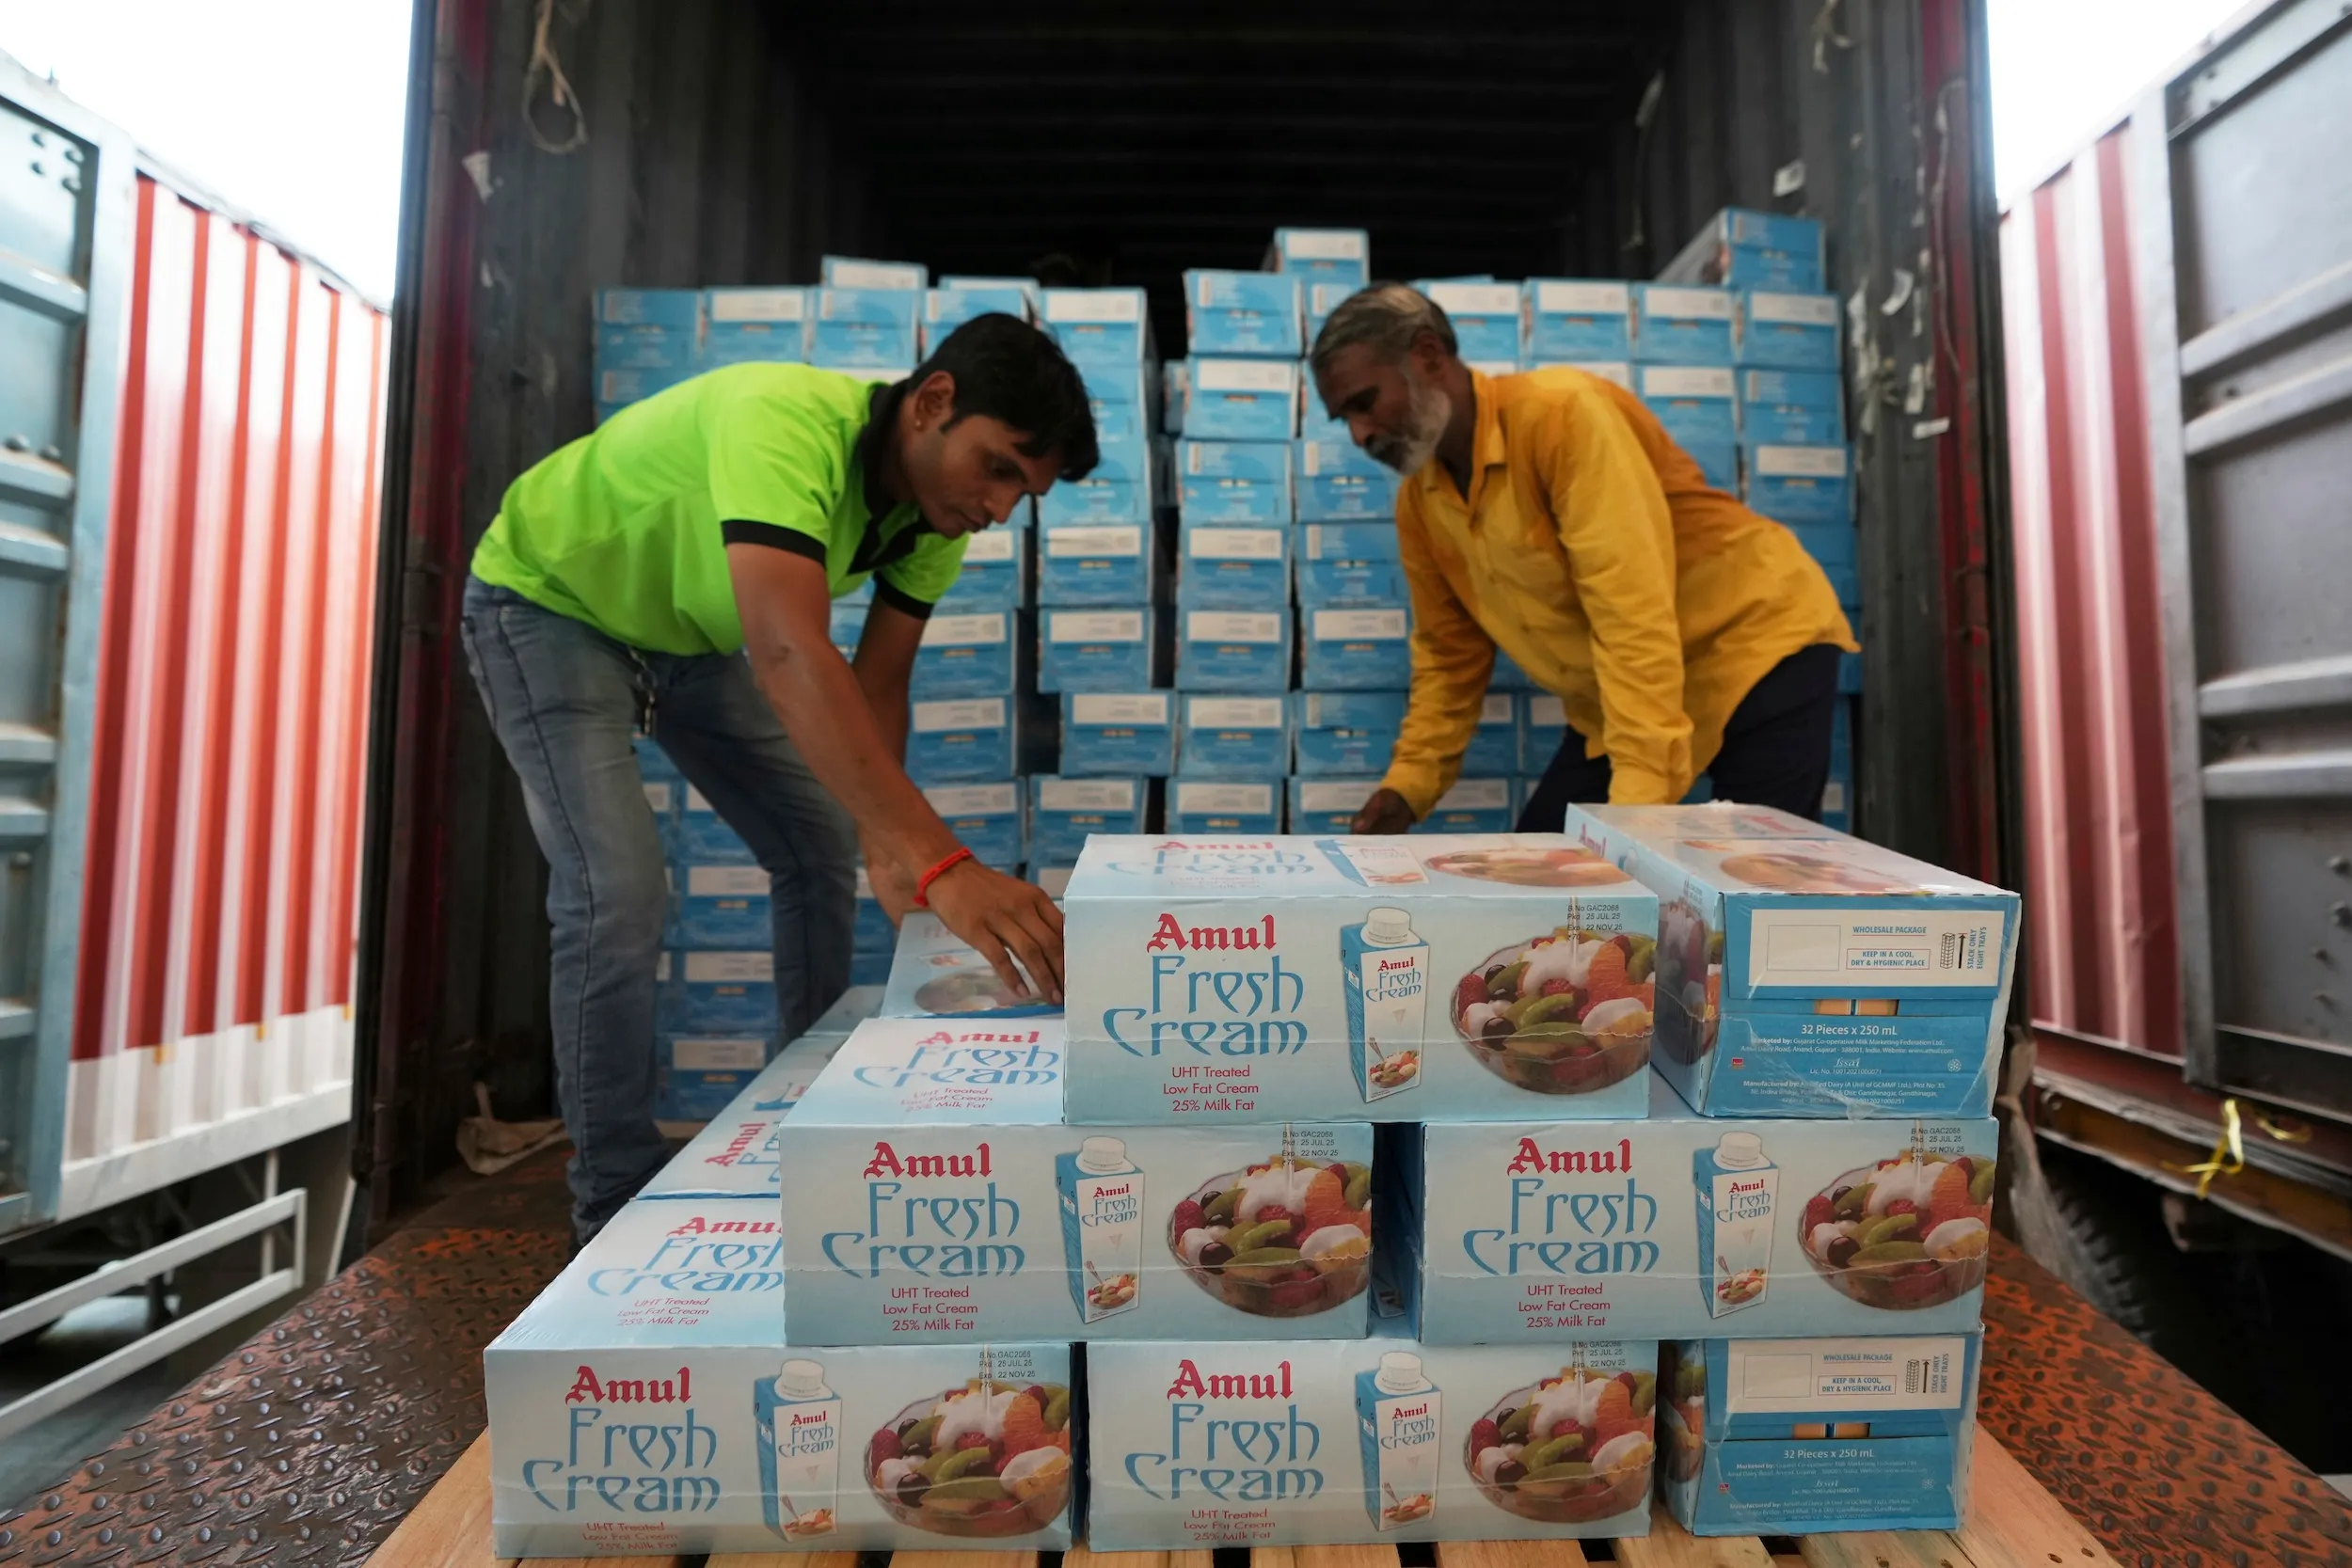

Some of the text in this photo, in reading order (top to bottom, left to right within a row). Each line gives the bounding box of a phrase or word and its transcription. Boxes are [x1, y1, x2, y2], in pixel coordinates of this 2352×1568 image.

[1147, 913, 1277, 953] Amul
[1977, 927, 1987, 969] EIGHT TRAYS
[1377, 957, 1414, 972] Amul
[1152, 955, 1303, 1017] Fresh
[1378, 967, 1422, 990] Fresh
[1365, 984, 1422, 1003] Cream
[915, 1031, 1040, 1046] Amul
[1103, 1008, 1308, 1057] Cream
[1802, 1024, 1898, 1036] 32 Pieces x 250 mL
[906, 1045, 1059, 1069] Fresh
[853, 1066, 1057, 1088] Cream
[1172, 1065, 1250, 1078] UHT Treated
[1163, 1083, 1259, 1095] Low Fat Cream
[1172, 1099, 1255, 1112] 25% Milk Fat
[704, 1122, 767, 1167] Amul
[863, 1141, 993, 1180] Amul
[1507, 1137, 1632, 1176] Amul
[1093, 1183, 1129, 1199] Amul
[1729, 1179, 1764, 1194] Amul
[1094, 1195, 1136, 1215] Fresh
[1511, 1178, 1658, 1238] Fresh
[1729, 1190, 1771, 1211] Fresh
[868, 1181, 1020, 1242] Fresh
[1082, 1211, 1137, 1227] Cream
[1716, 1205, 1771, 1223] Cream
[666, 1216, 781, 1237] Amu
[821, 1232, 1025, 1279] Cream
[1463, 1229, 1660, 1275] Cream
[588, 1269, 784, 1296] Cream
[1528, 1282, 1603, 1296] UHT Treated
[891, 1286, 969, 1299] UHT Treated
[634, 1299, 661, 1307] UHT
[882, 1303, 978, 1315] Low Fat Cream
[1518, 1299, 1611, 1312] Low Fat Cream
[647, 1317, 675, 1325] Milk
[892, 1318, 975, 1331] 25% Milk Fat
[1527, 1315, 1606, 1328] 25% Milk Fat
[564, 1366, 691, 1405] Amul
[1167, 1359, 1294, 1401] Amul
[790, 1410, 827, 1427] Amul
[1392, 1403, 1427, 1419] Amul
[791, 1422, 834, 1445] Fresh
[1172, 1403, 1320, 1465] Fresh
[1393, 1415, 1435, 1437] Fresh
[568, 1408, 717, 1472] Fresh
[778, 1439, 834, 1458] Cream
[1380, 1431, 1435, 1450] Cream
[1784, 1449, 1795, 1459] 32
[1797, 1449, 1828, 1459] Pieces
[1839, 1449, 1857, 1458] 250
[1859, 1449, 1875, 1458] mL
[522, 1460, 721, 1513] Cream
[1124, 1452, 1324, 1502] Cream
[1191, 1509, 1267, 1519] UHT Treated
[586, 1522, 665, 1531] UHT Treated
[1212, 1521, 1231, 1529] Fat
[1234, 1520, 1276, 1528] Cream
[612, 1532, 631, 1541] Fat
[635, 1532, 678, 1541] Cream
[628, 1542, 654, 1550] Milk
[658, 1541, 678, 1549] Fat
[1193, 1531, 1271, 1541] 25% Milk Fat
